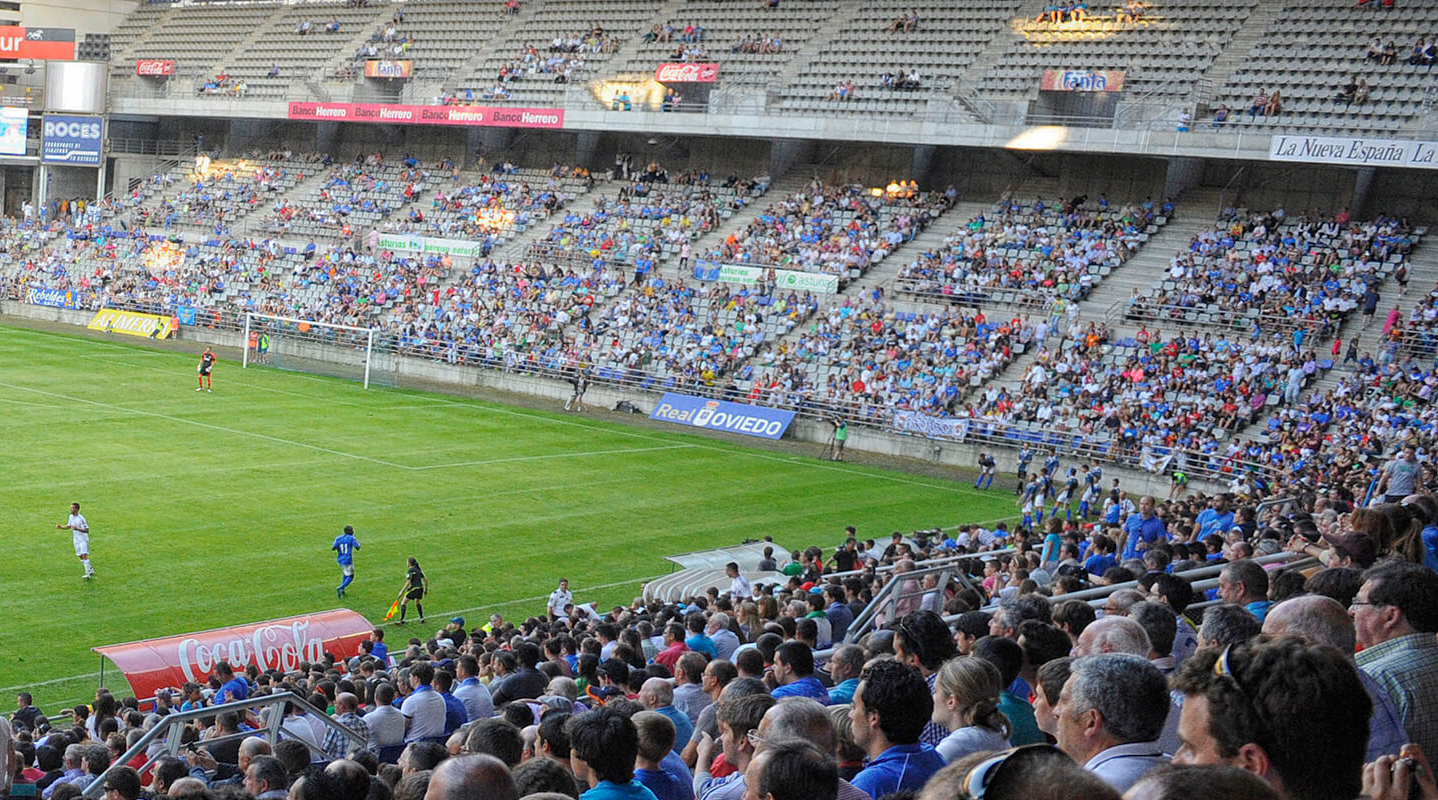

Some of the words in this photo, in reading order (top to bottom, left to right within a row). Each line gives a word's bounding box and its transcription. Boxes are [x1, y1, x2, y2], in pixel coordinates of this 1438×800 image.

[1063, 71, 1107, 89] Fanta
[44, 121, 100, 139] ROCES
[1275, 137, 1297, 156] La
[1299, 138, 1344, 158] Nueva
[1346, 141, 1404, 163] España
[1412, 143, 1435, 163] La
[655, 403, 697, 422] Real
[711, 412, 782, 436] OVIEDO
[339, 543, 348, 554] 11
